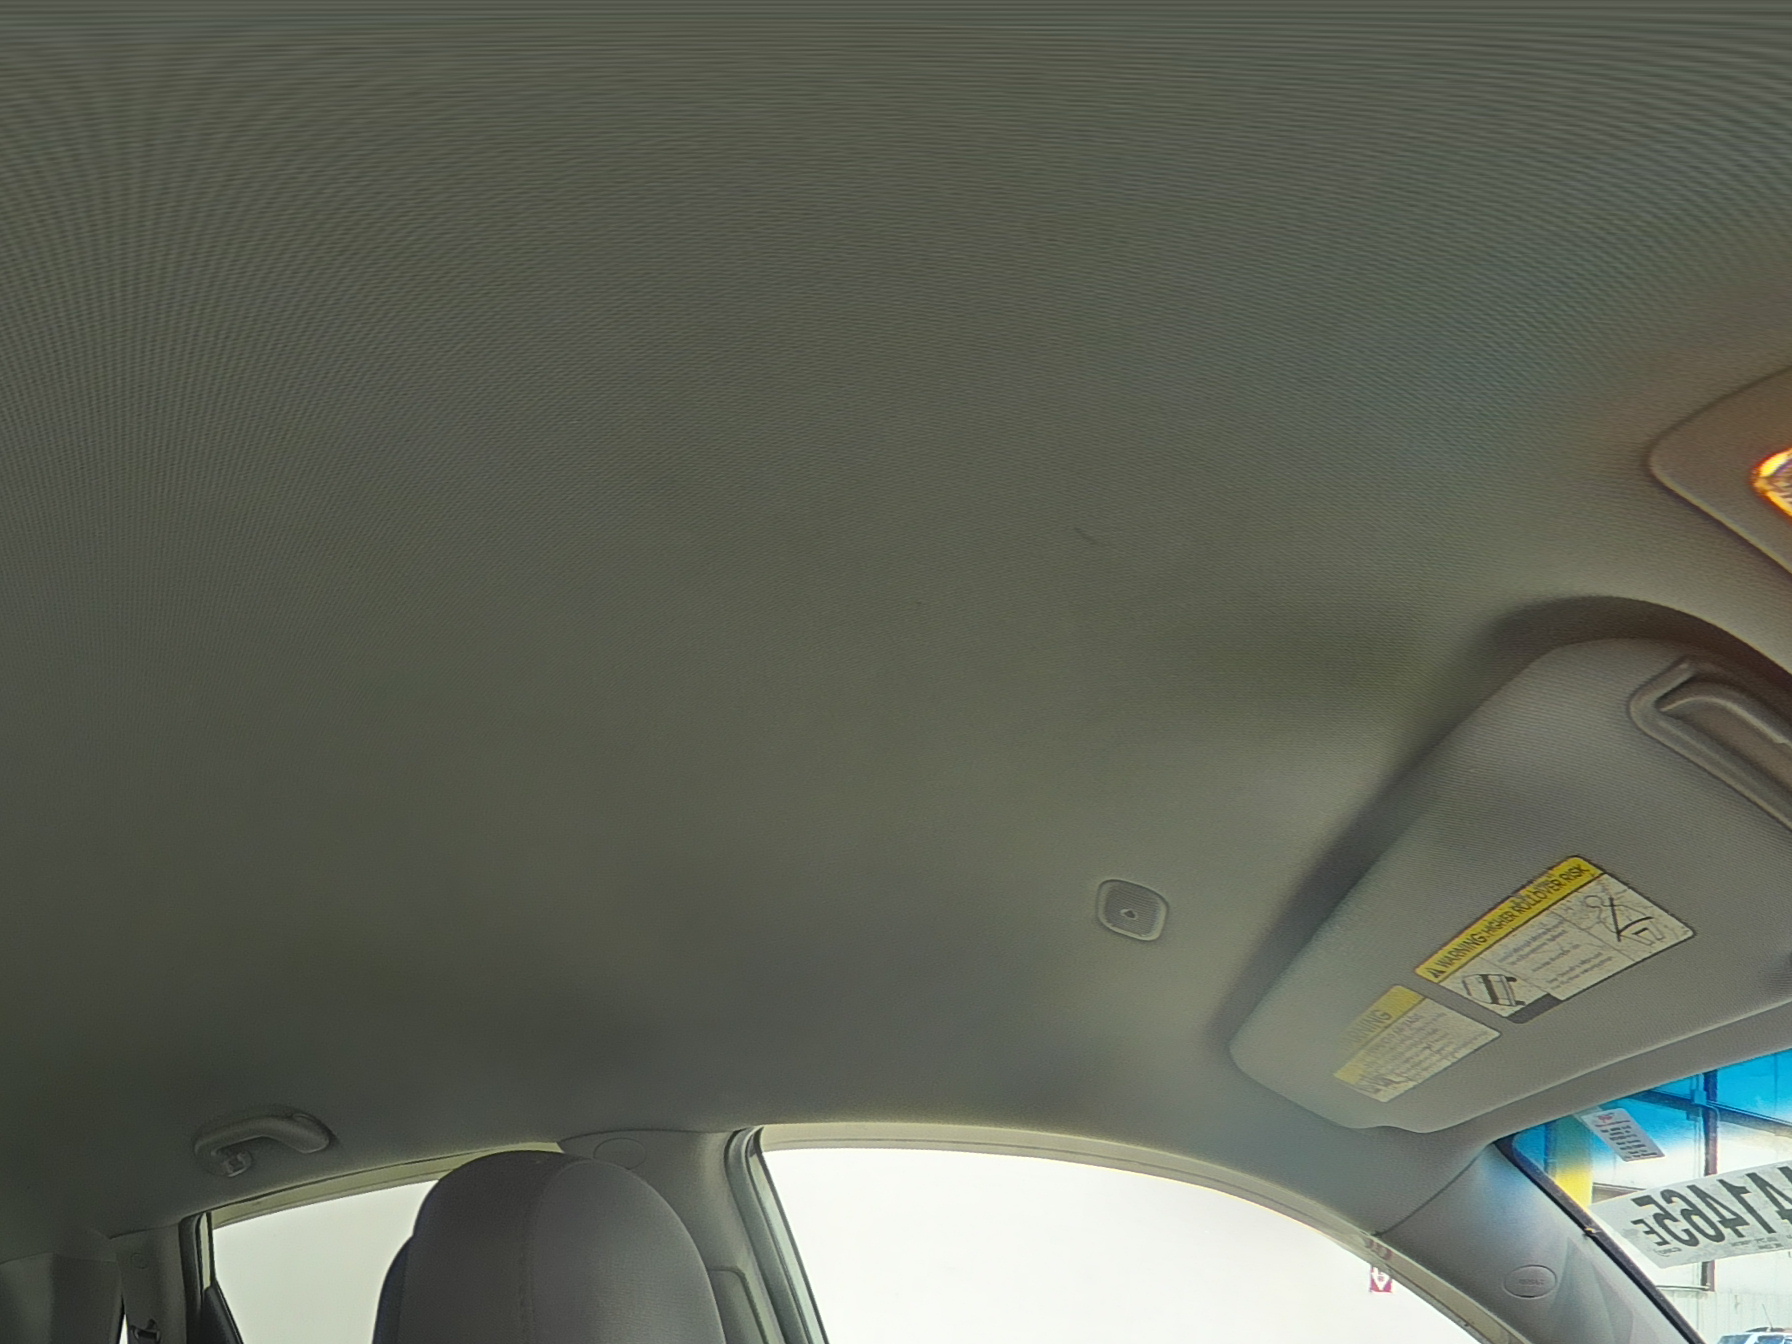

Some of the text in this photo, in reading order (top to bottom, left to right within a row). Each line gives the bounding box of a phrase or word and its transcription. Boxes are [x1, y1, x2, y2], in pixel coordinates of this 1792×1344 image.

[1483, 910, 1517, 938] HIGHER
[1512, 879, 1563, 916] ROLLOVER
[1559, 863, 1590, 884] RISK
